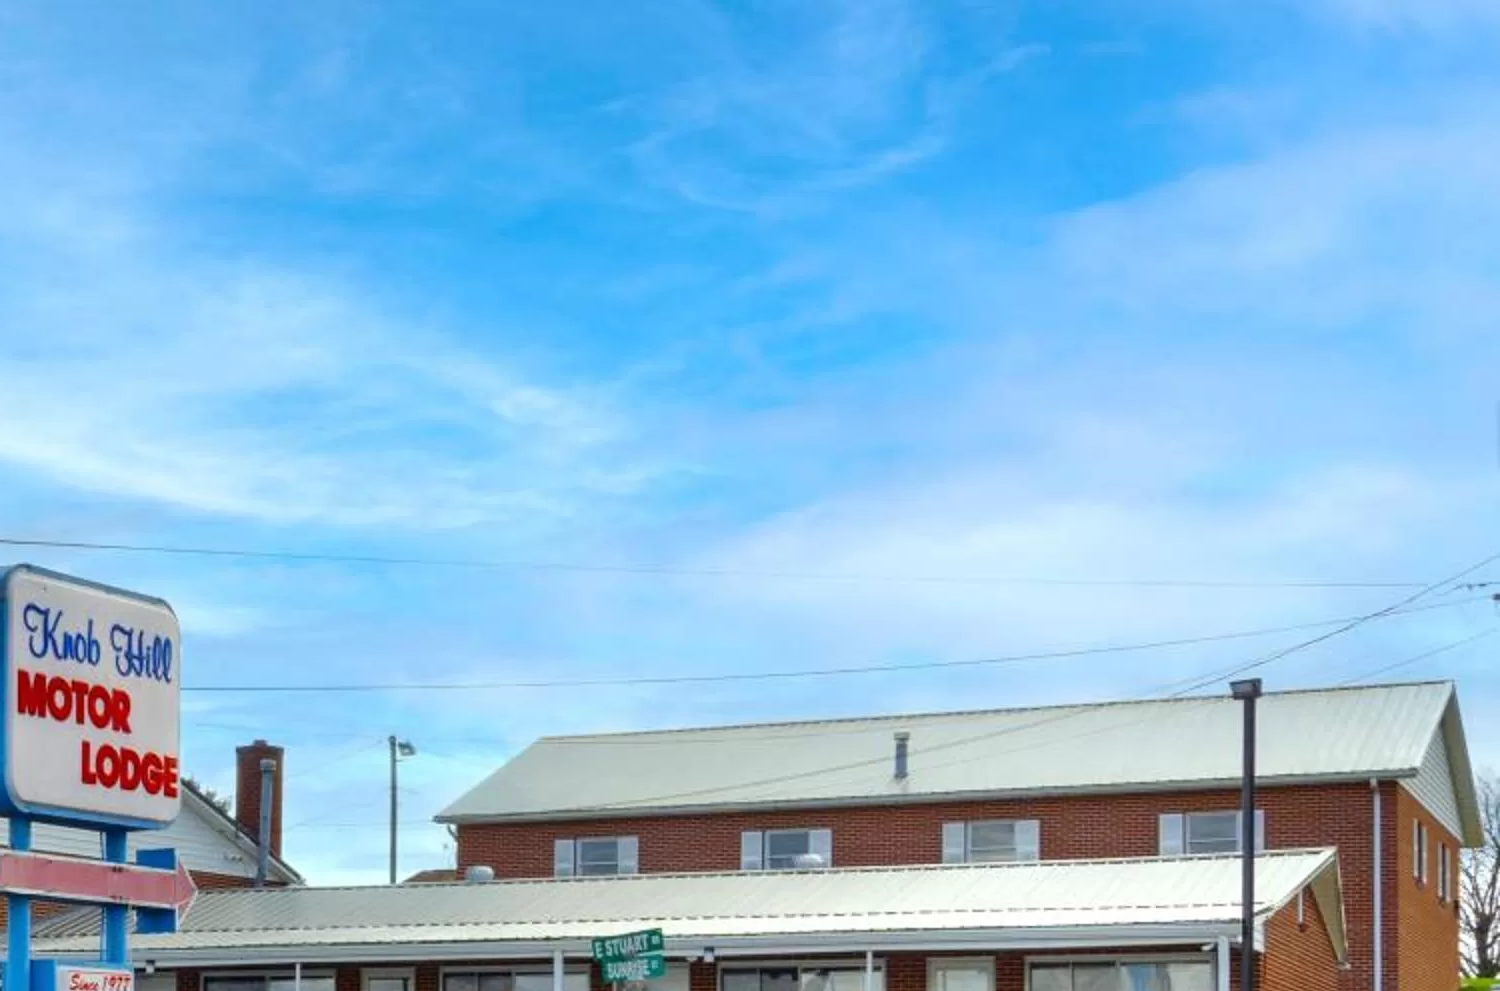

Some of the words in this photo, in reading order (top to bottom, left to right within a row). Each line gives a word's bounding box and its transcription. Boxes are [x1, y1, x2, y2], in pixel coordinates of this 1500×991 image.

[23, 602, 100, 666] Knob
[110, 623, 173, 684] Hill
[17, 668, 132, 734] MOTOR
[81, 740, 178, 799] LODGE
[595, 941, 604, 959] E
[604, 934, 649, 957] STUART
[69, 973, 99, 991] Since
